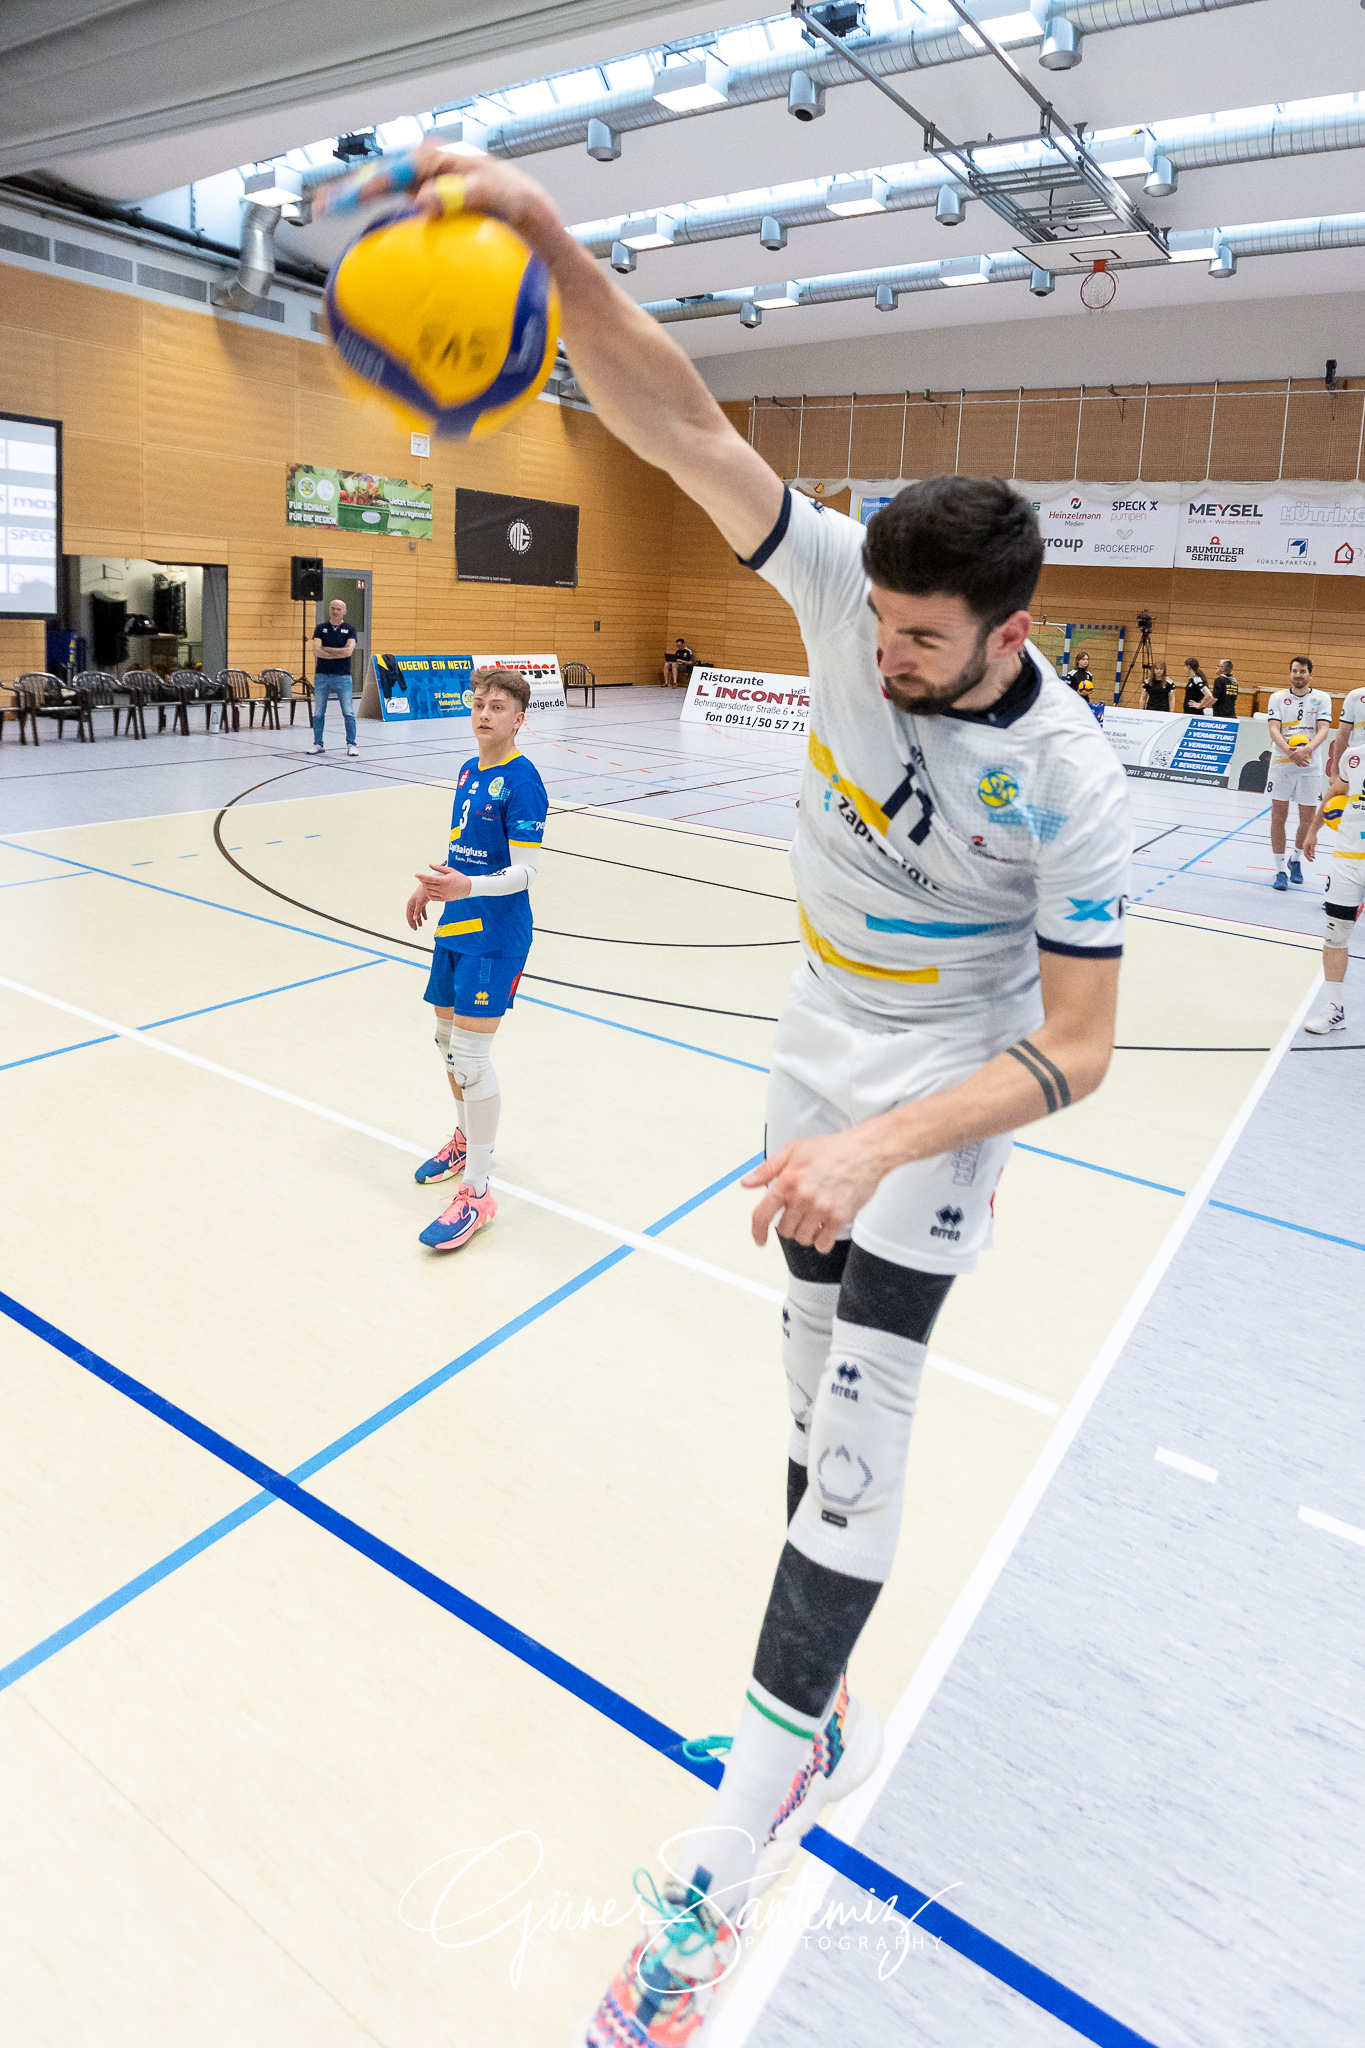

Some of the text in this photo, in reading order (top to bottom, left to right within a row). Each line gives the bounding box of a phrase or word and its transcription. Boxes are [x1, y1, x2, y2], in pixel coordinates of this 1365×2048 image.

[1112, 500, 1146, 511] SPECK
[1188, 503, 1264, 518] MEYSEL
[1049, 511, 1101, 520] Heinzelmann
[1111, 511, 1147, 522] pumpen
[1215, 519, 1262, 527] Werbetechnik
[1042, 537, 1084, 553] roup
[1093, 544, 1155, 554] BROCKERHOF
[1191, 553, 1237, 563] SERVICES
[431, 661, 446, 670] EIN
[447, 660, 472, 670] NETZ!
[700, 671, 764, 687] Ristorante
[693, 698, 755, 713] Behringersdorfer
[756, 704, 781, 715] Straße
[782, 708, 788, 716] 6
[1296, 709, 1304, 721] 8
[705, 711, 805, 732] fon 0911/50 57 71
[1197, 721, 1228, 730] VERKAUF
[1192, 731, 1235, 742] VERMIETUNG
[1188, 741, 1232, 752] VERWALTUNG
[1182, 751, 1218, 761] BERATUNG
[1177, 760, 1219, 772] BEWERTUNG
[1267, 781, 1273, 793] 8
[459, 799, 471, 830] 3
